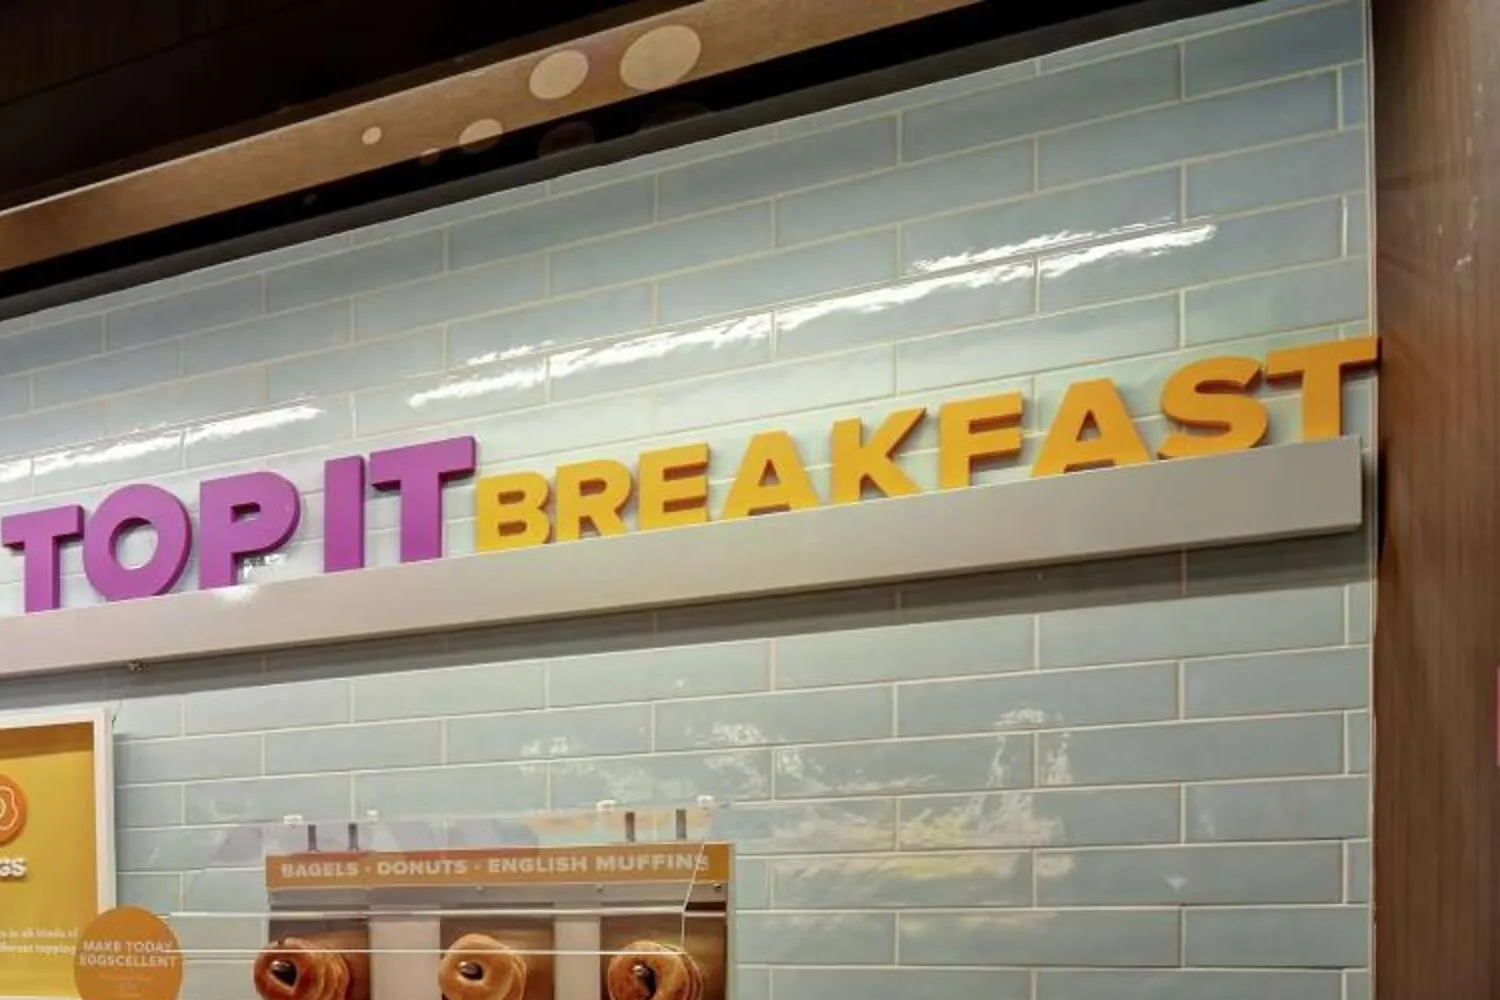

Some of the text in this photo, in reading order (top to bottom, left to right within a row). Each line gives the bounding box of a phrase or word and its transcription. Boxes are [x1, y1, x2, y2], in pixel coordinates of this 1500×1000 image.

[1, 337, 1380, 614] TOP IT BREAKFAST
[281, 852, 709, 879] BAGELS DONUTS ENGLISH MUFFINS
[83, 940, 173, 953] MAKE TODAY
[79, 953, 176, 968] EGGSCELLENT
